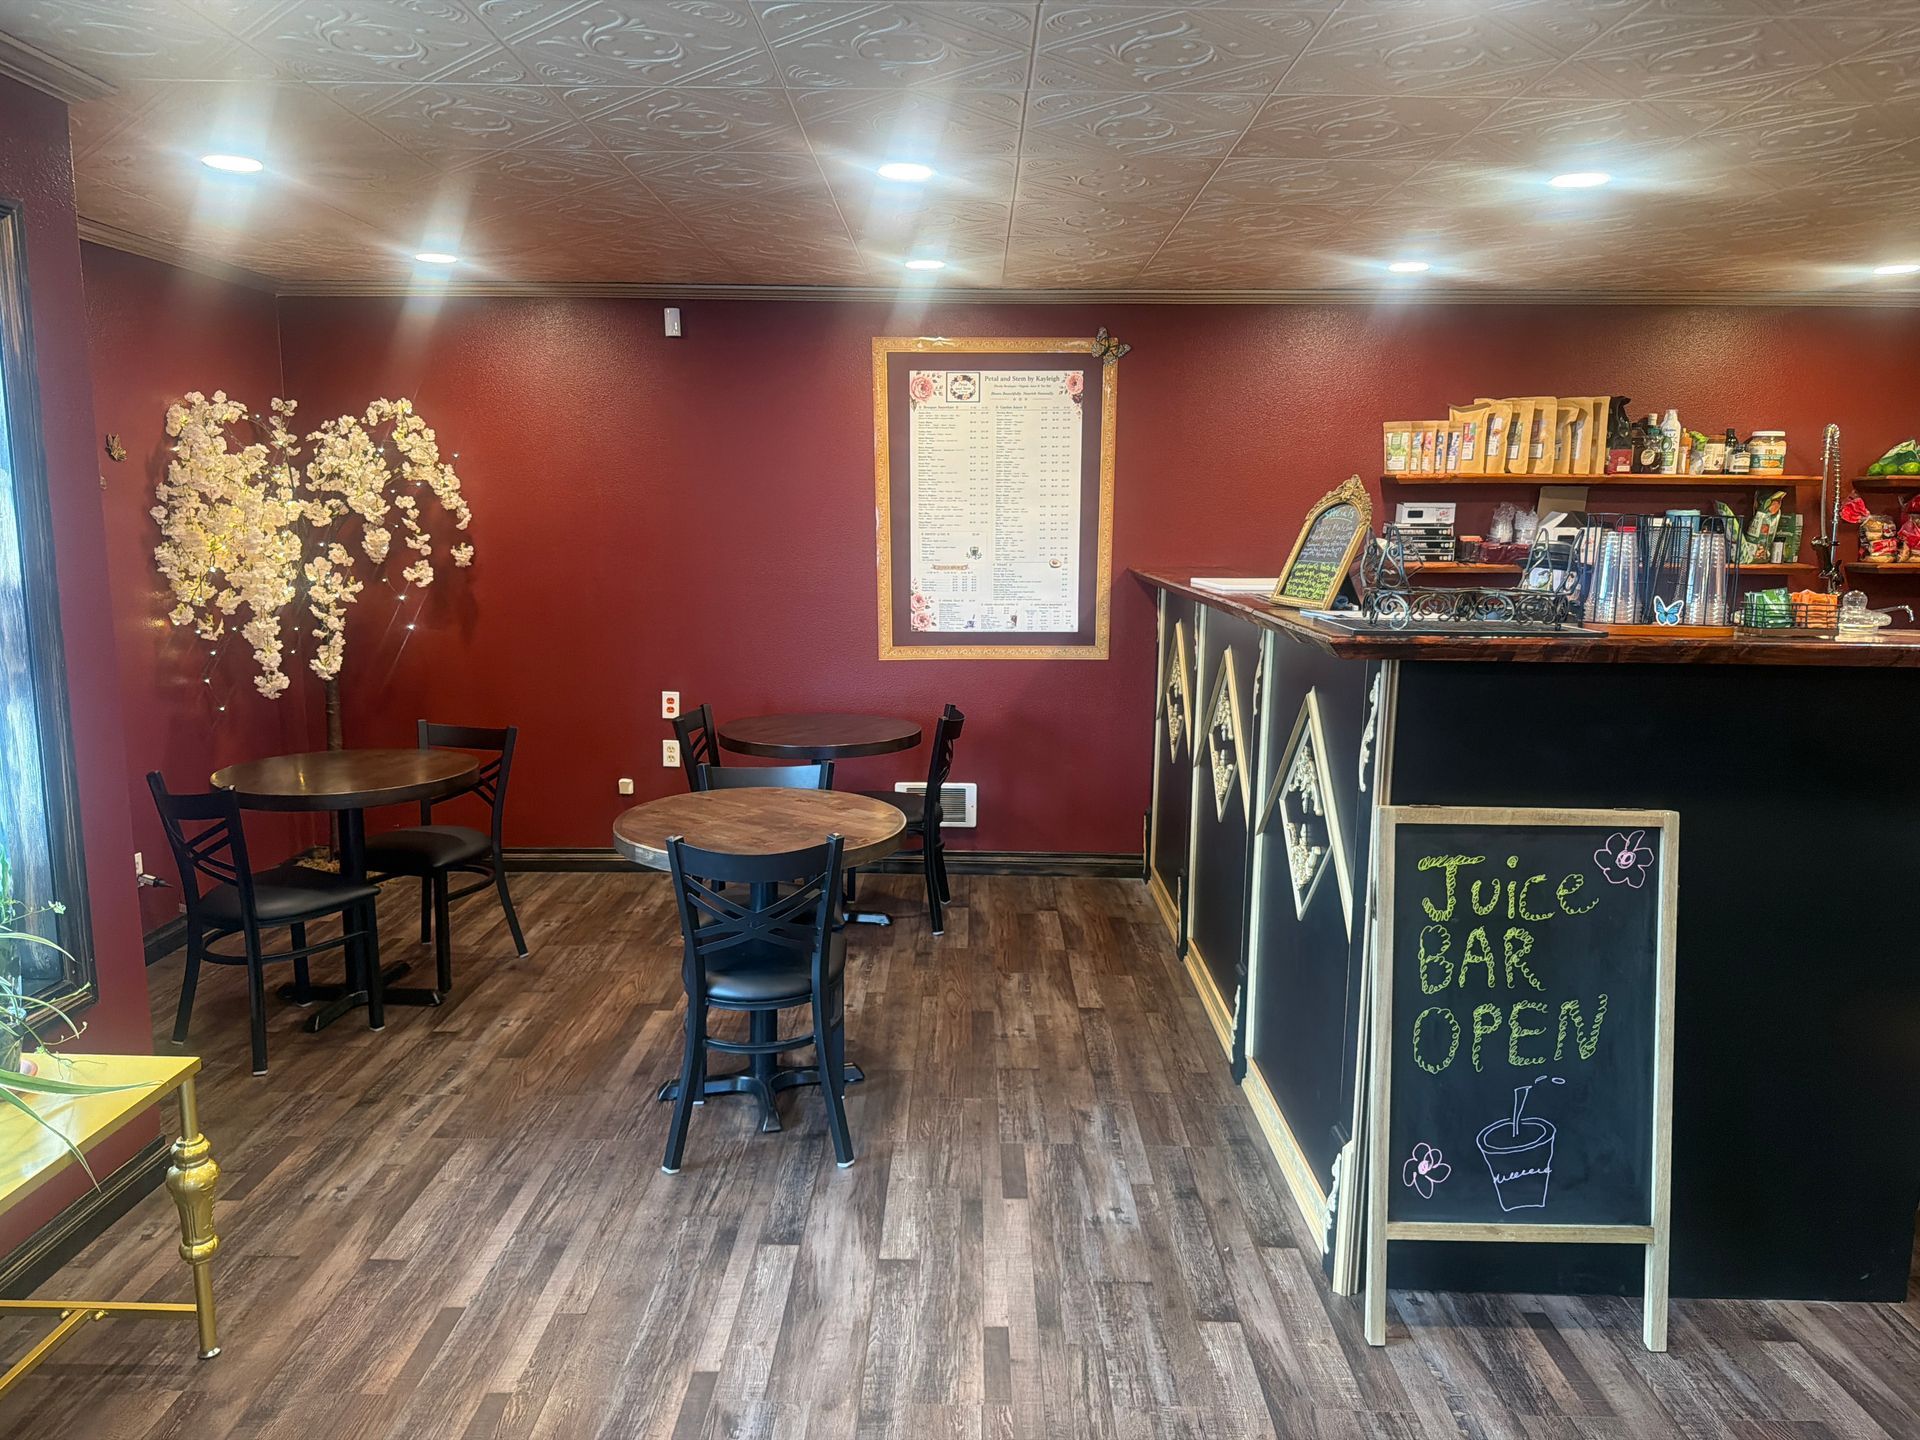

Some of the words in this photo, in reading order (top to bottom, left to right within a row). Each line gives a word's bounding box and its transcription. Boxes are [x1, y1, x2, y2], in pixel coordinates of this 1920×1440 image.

[1417, 855, 1600, 921] Juice
[1418, 924, 1547, 995] BAR
[1413, 993, 1608, 1075] OPEN
